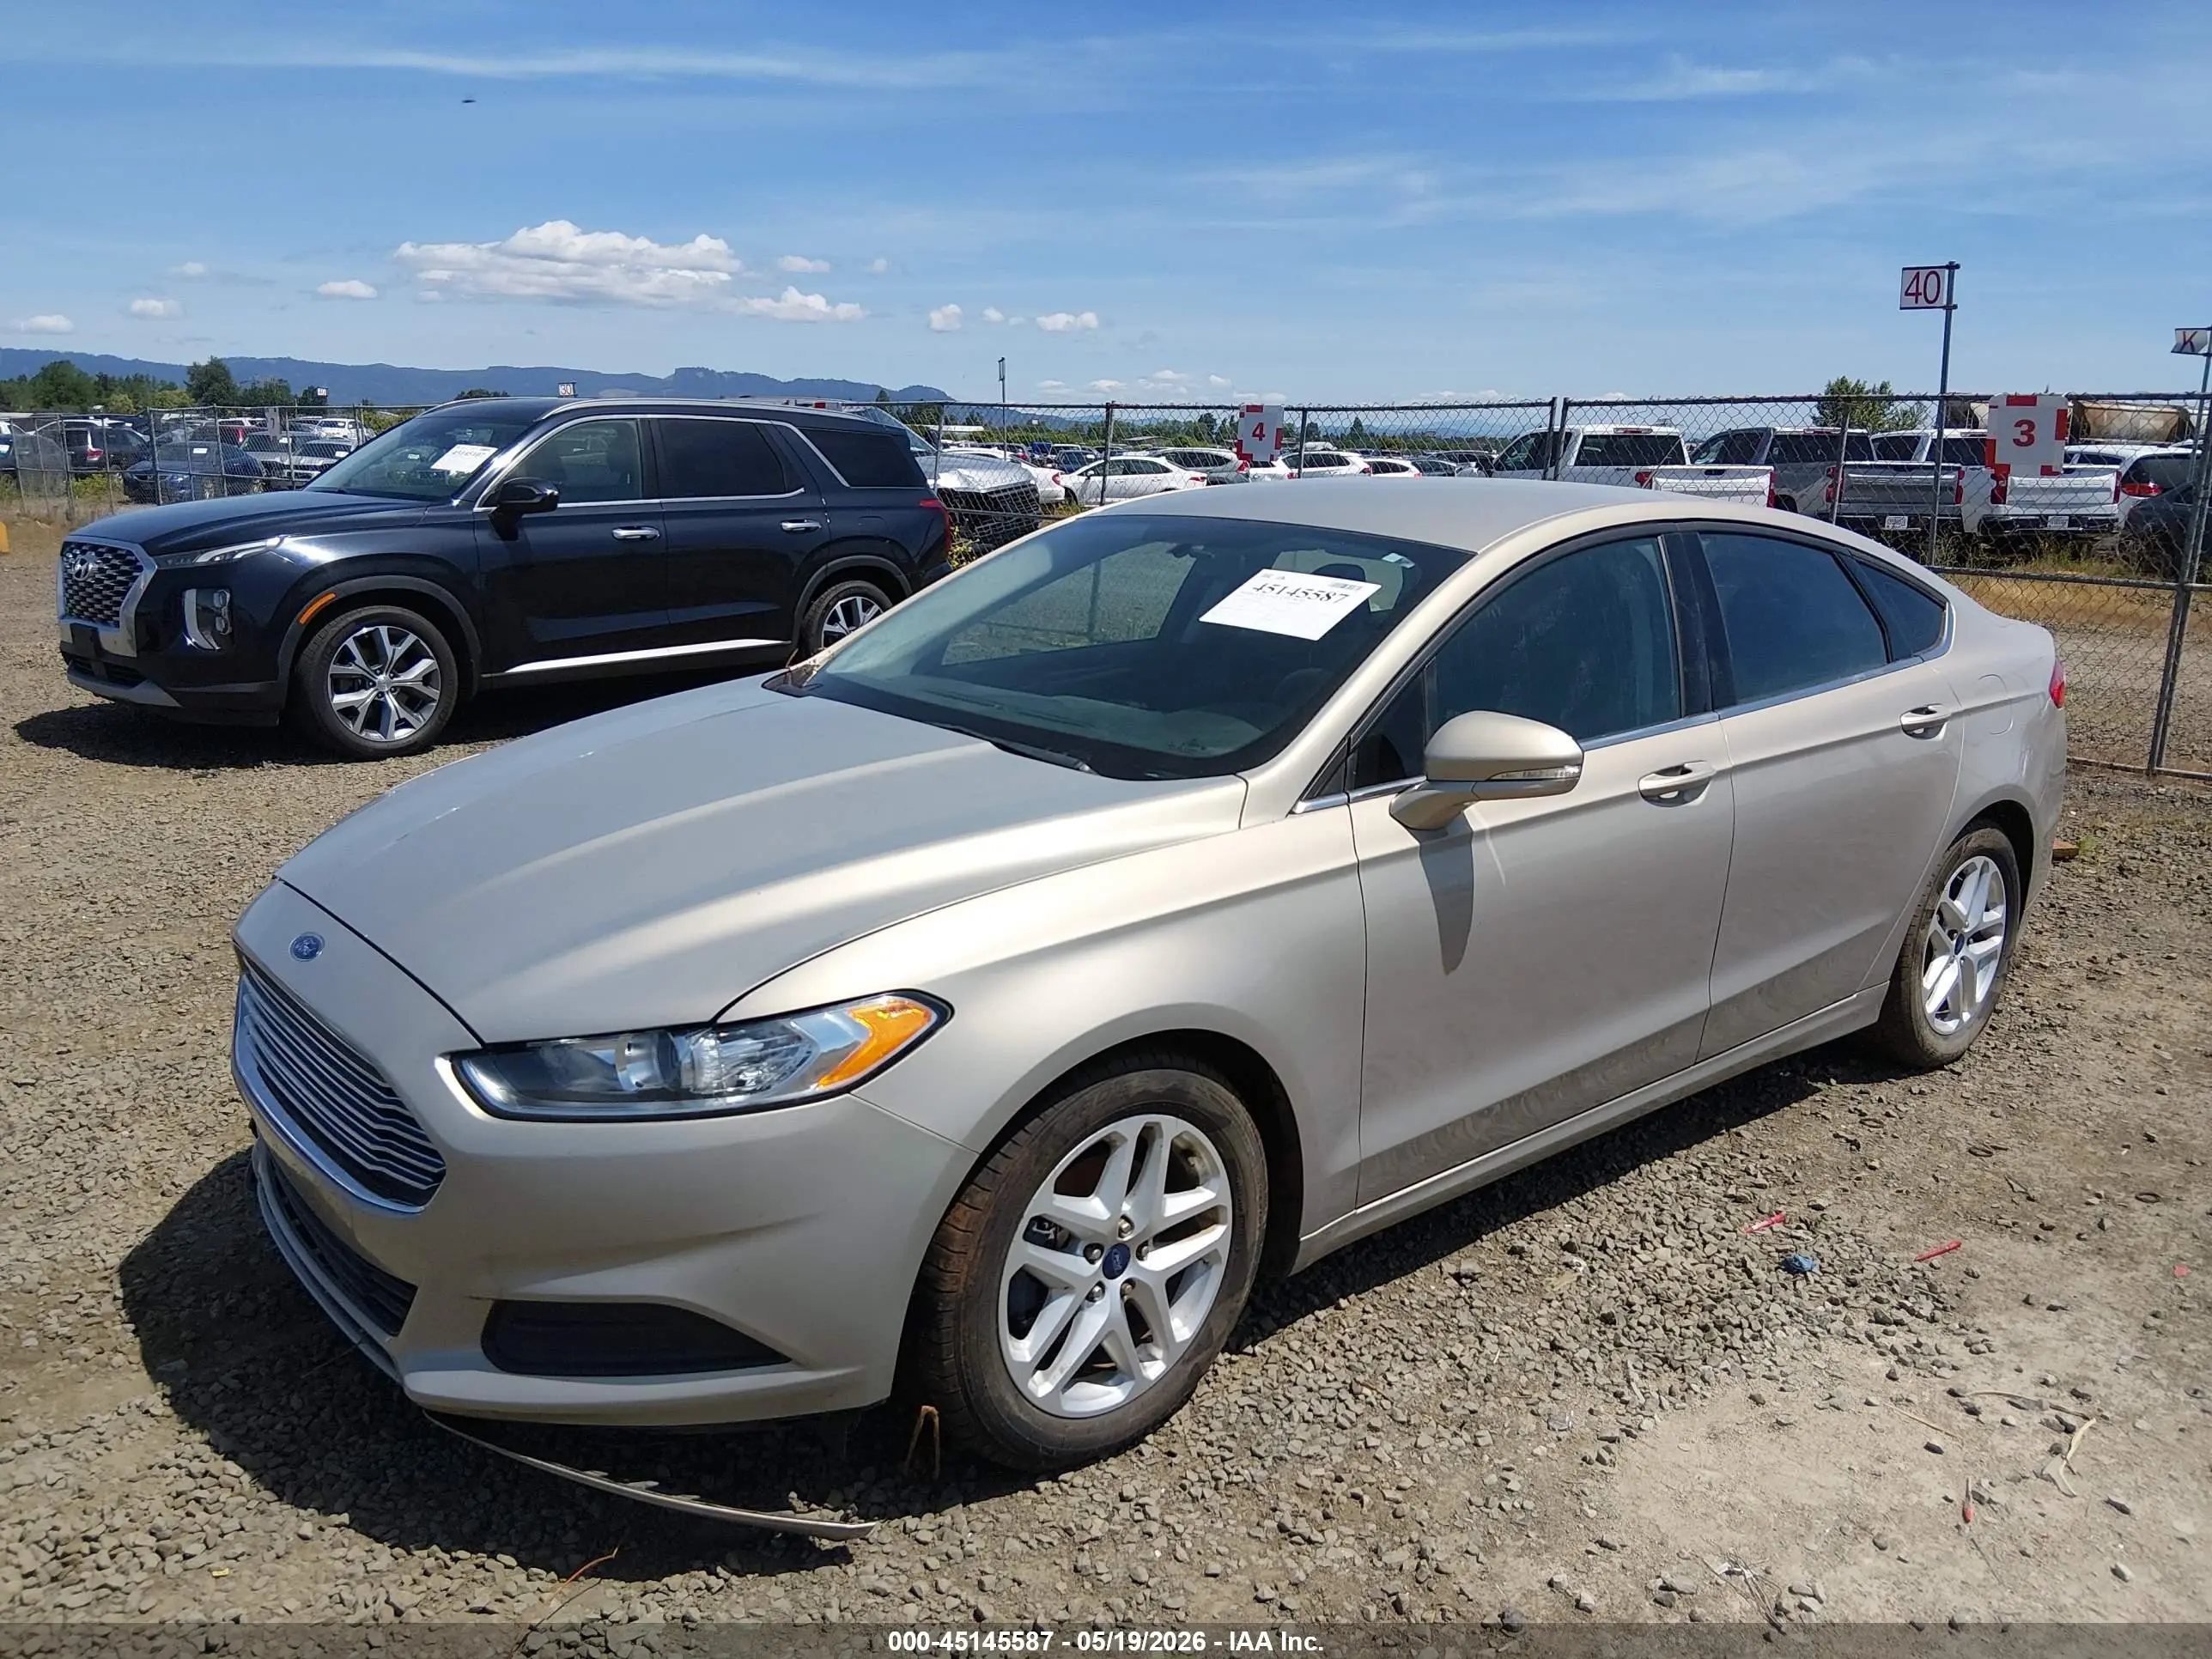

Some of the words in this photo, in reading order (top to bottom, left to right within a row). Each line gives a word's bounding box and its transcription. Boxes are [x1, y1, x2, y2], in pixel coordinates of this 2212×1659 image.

[1904, 270, 1941, 305] 40
[2180, 331, 2198, 352] K
[560, 384, 573, 395] 30
[1252, 422, 1266, 441] 4
[2013, 419, 2036, 447] 3
[1253, 582, 1351, 604] 45145587
